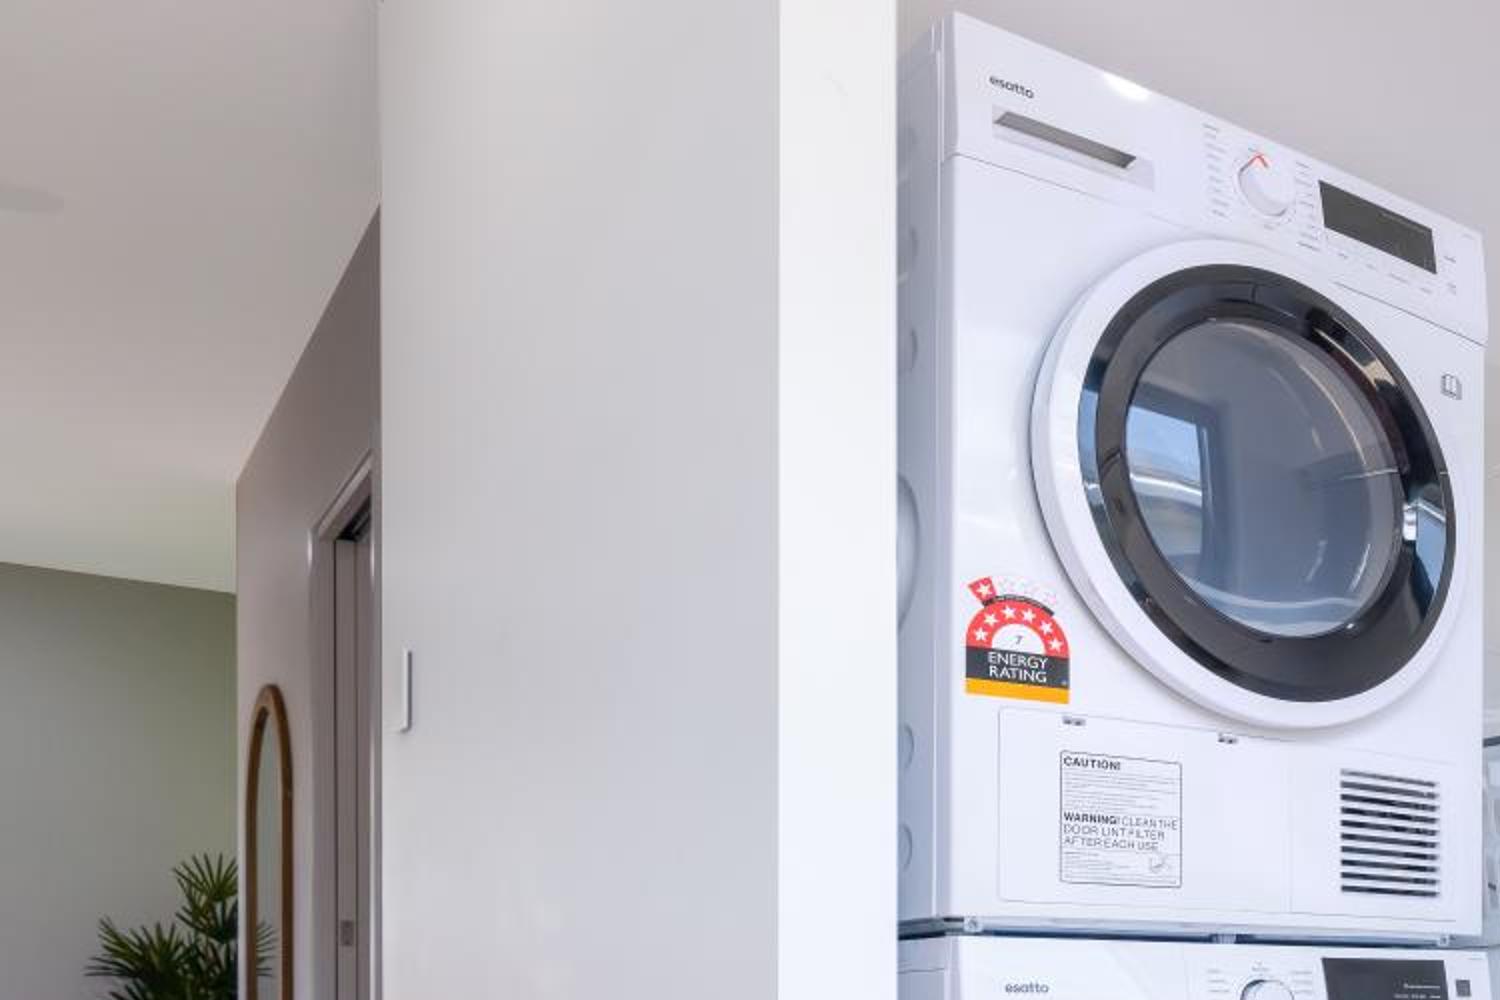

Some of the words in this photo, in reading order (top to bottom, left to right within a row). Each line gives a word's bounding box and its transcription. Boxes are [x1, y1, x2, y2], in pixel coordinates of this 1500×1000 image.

[988, 76, 1035, 99] esatto
[987, 651, 1049, 670] ENERGY
[988, 664, 1048, 684] RATING
[1063, 755, 1121, 771] CAUTION!
[1063, 823, 1099, 836] DOOR
[1158, 818, 1178, 831] THE
[1063, 836, 1102, 848] AFTER
[1103, 838, 1135, 850] EACH
[1004, 980, 1049, 993] esatto
